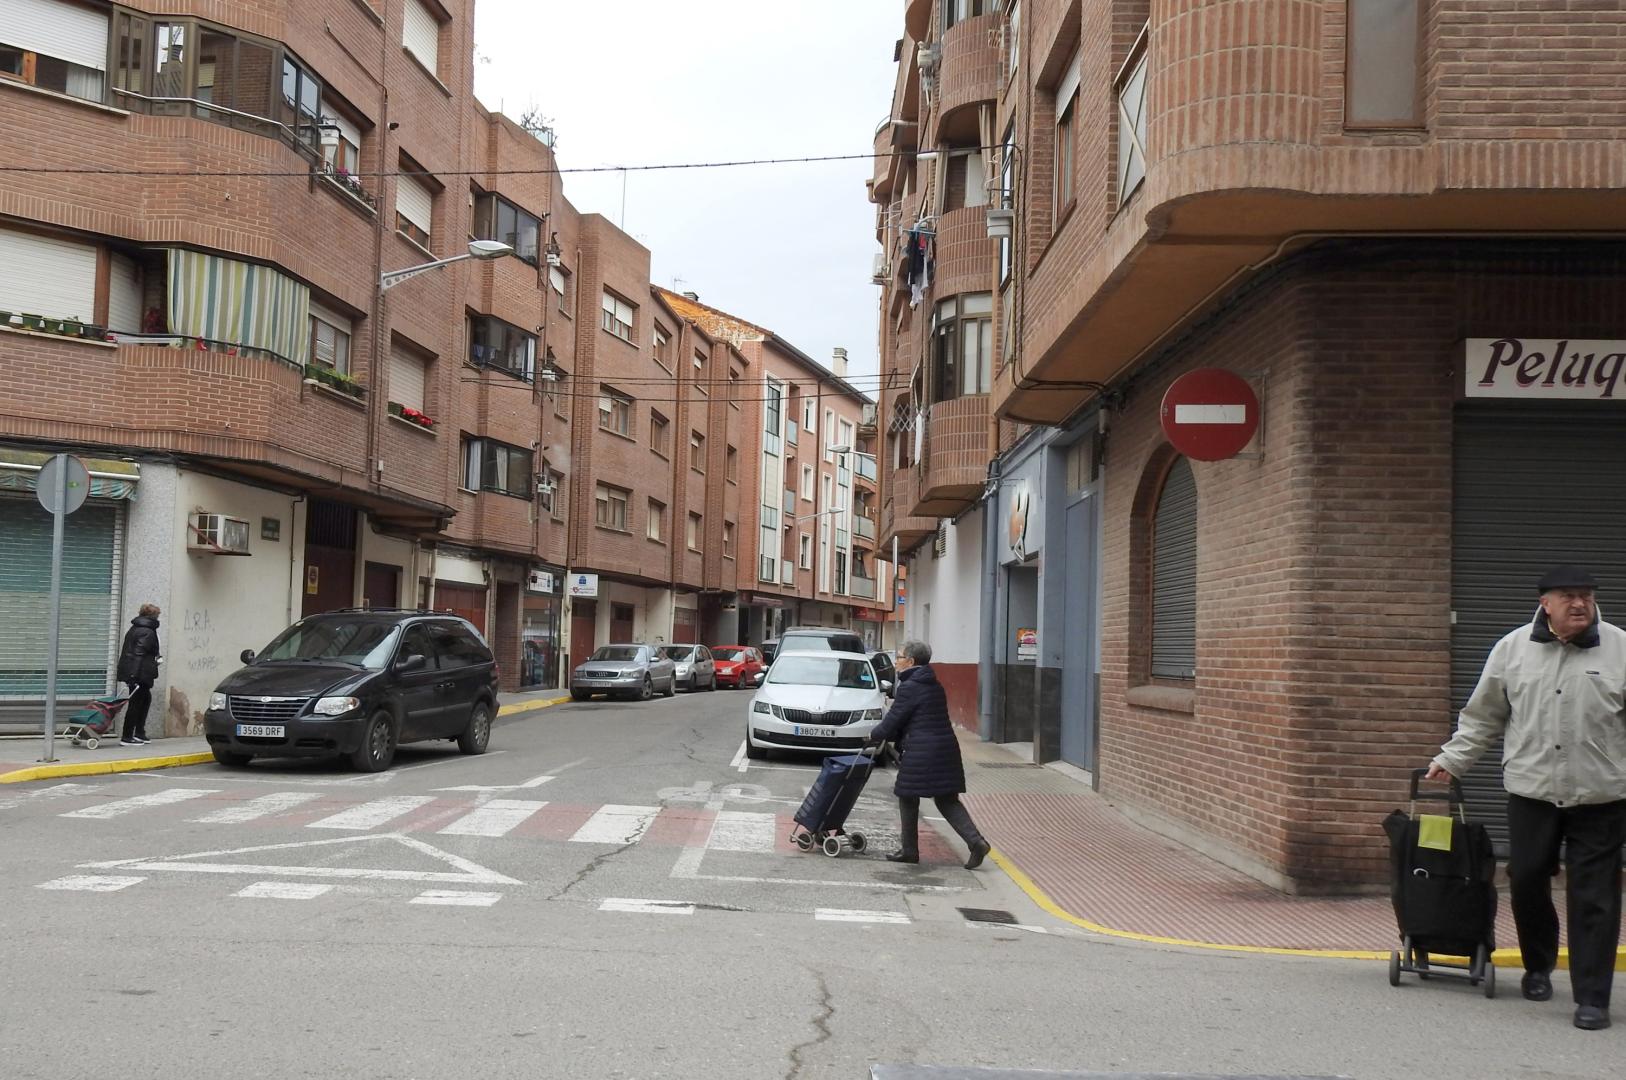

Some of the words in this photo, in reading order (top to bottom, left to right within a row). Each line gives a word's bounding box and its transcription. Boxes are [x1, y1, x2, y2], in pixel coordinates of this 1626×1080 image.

[1478, 338, 1626, 398] Peluq
[243, 727, 263, 735] 3569
[800, 728, 819, 736] 3807
